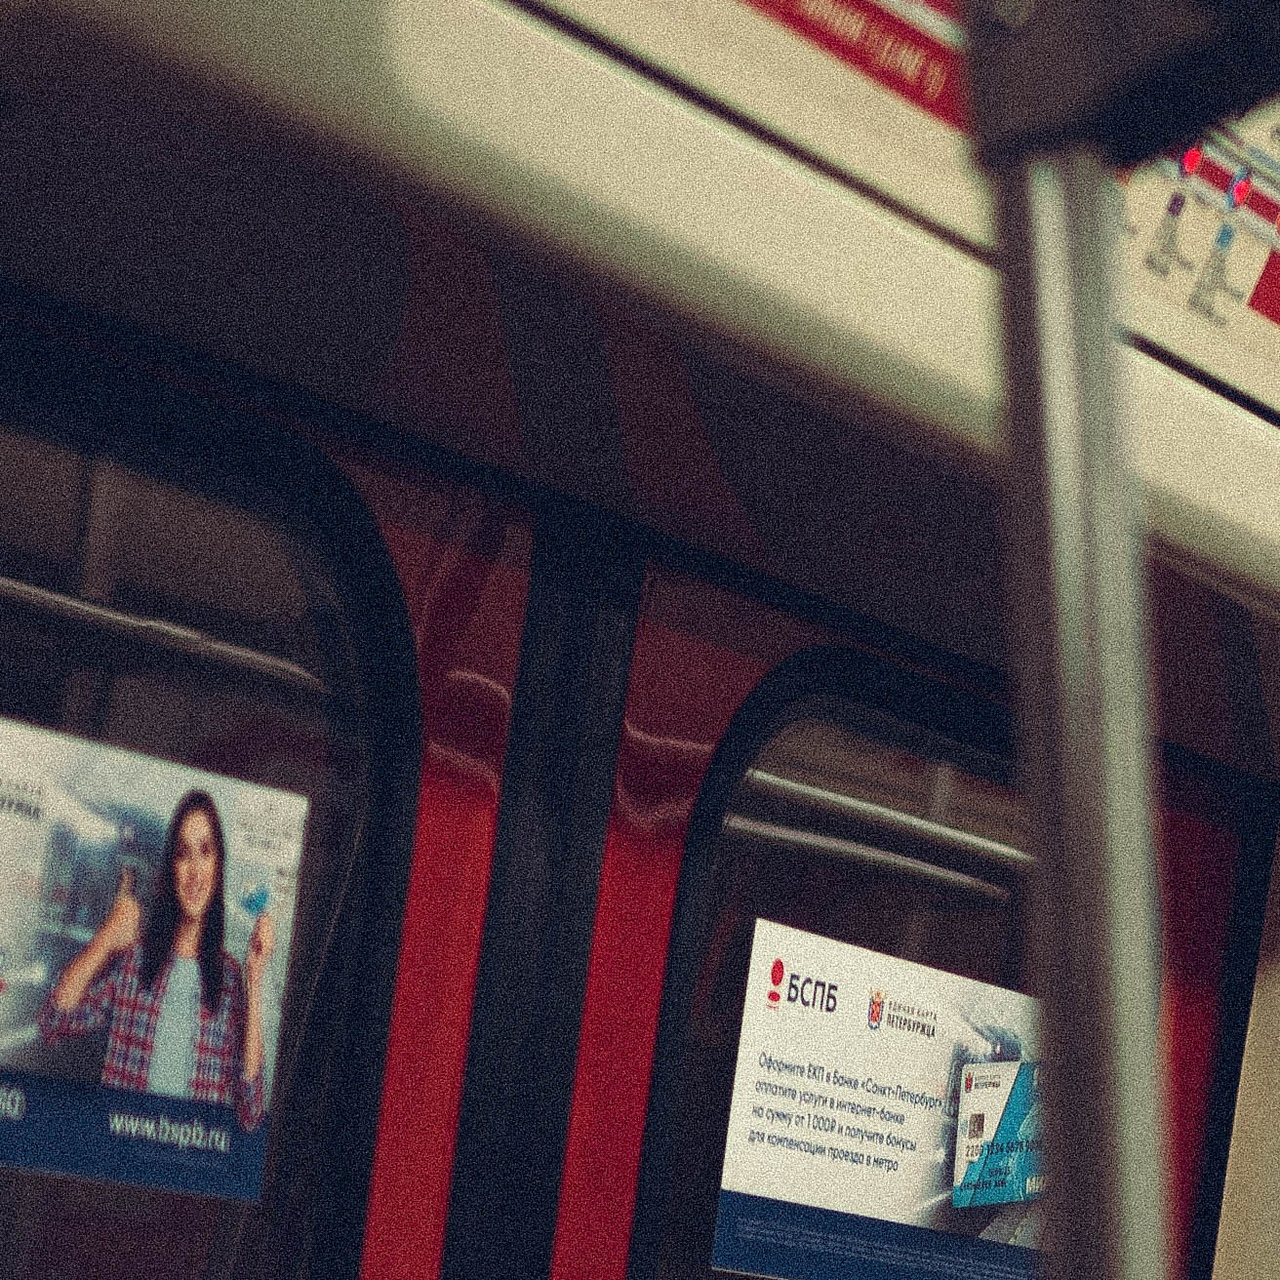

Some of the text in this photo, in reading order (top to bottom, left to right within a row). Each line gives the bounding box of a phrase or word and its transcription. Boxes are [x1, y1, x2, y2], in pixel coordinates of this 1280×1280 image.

[787, 973, 838, 1013] БСПБ
[758, 1051, 805, 1076] Оформите
[807, 1062, 825, 1081] ЕКП
[832, 1069, 859, 1089] Банке
[755, 1080, 797, 1101] оплатите
[799, 1090, 828, 1108] услуги
[836, 1101, 905, 1125] интернет-банке
[108, 1113, 230, 1152] www.bspb.ru
[752, 1106, 764, 1118] на
[765, 1108, 792, 1128] сумму
[795, 1115, 805, 1127] от
[845, 1126, 884, 1144] получите
[886, 1132, 916, 1153] бонусы
[767, 1134, 826, 1155] компенсации
[873, 1158, 899, 1172] метро
